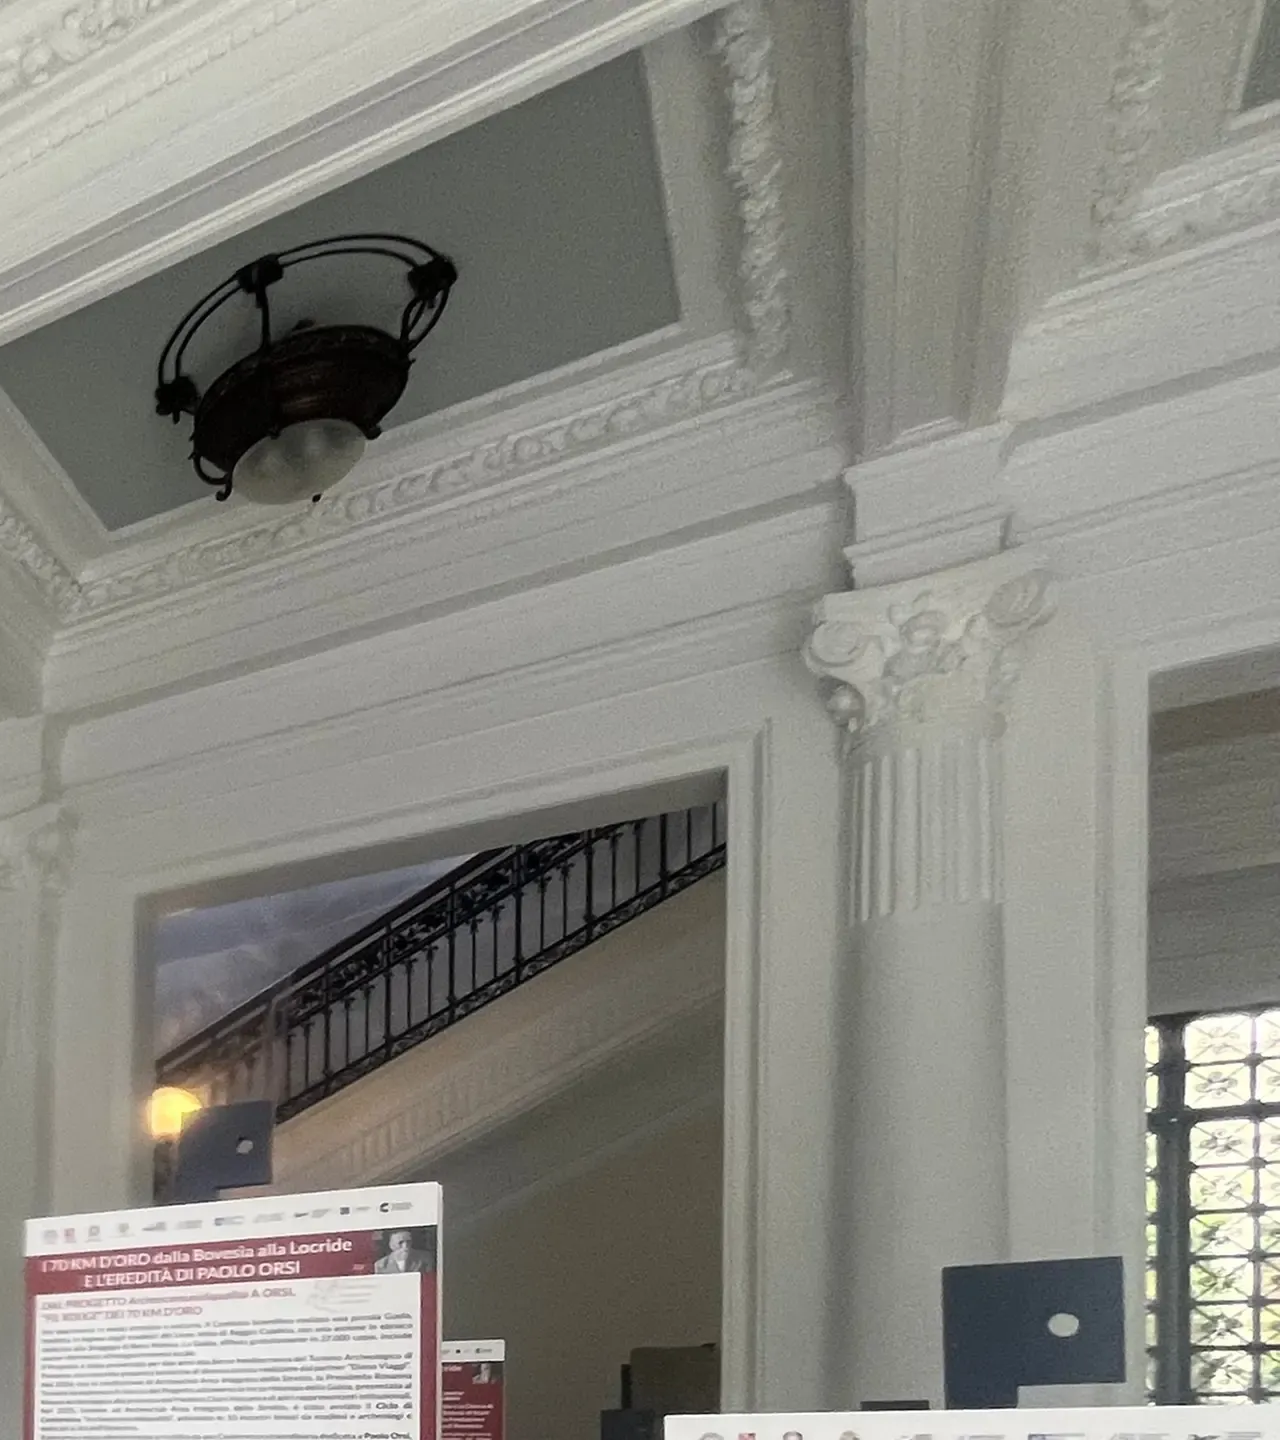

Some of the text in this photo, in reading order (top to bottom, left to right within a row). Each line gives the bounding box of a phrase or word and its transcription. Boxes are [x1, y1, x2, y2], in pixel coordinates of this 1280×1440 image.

[83, 1274, 94, 1288] E
[174, 1267, 194, 1282] DI
[195, 1263, 256, 1280] PAOLO
[257, 1259, 300, 1277] ORSI
